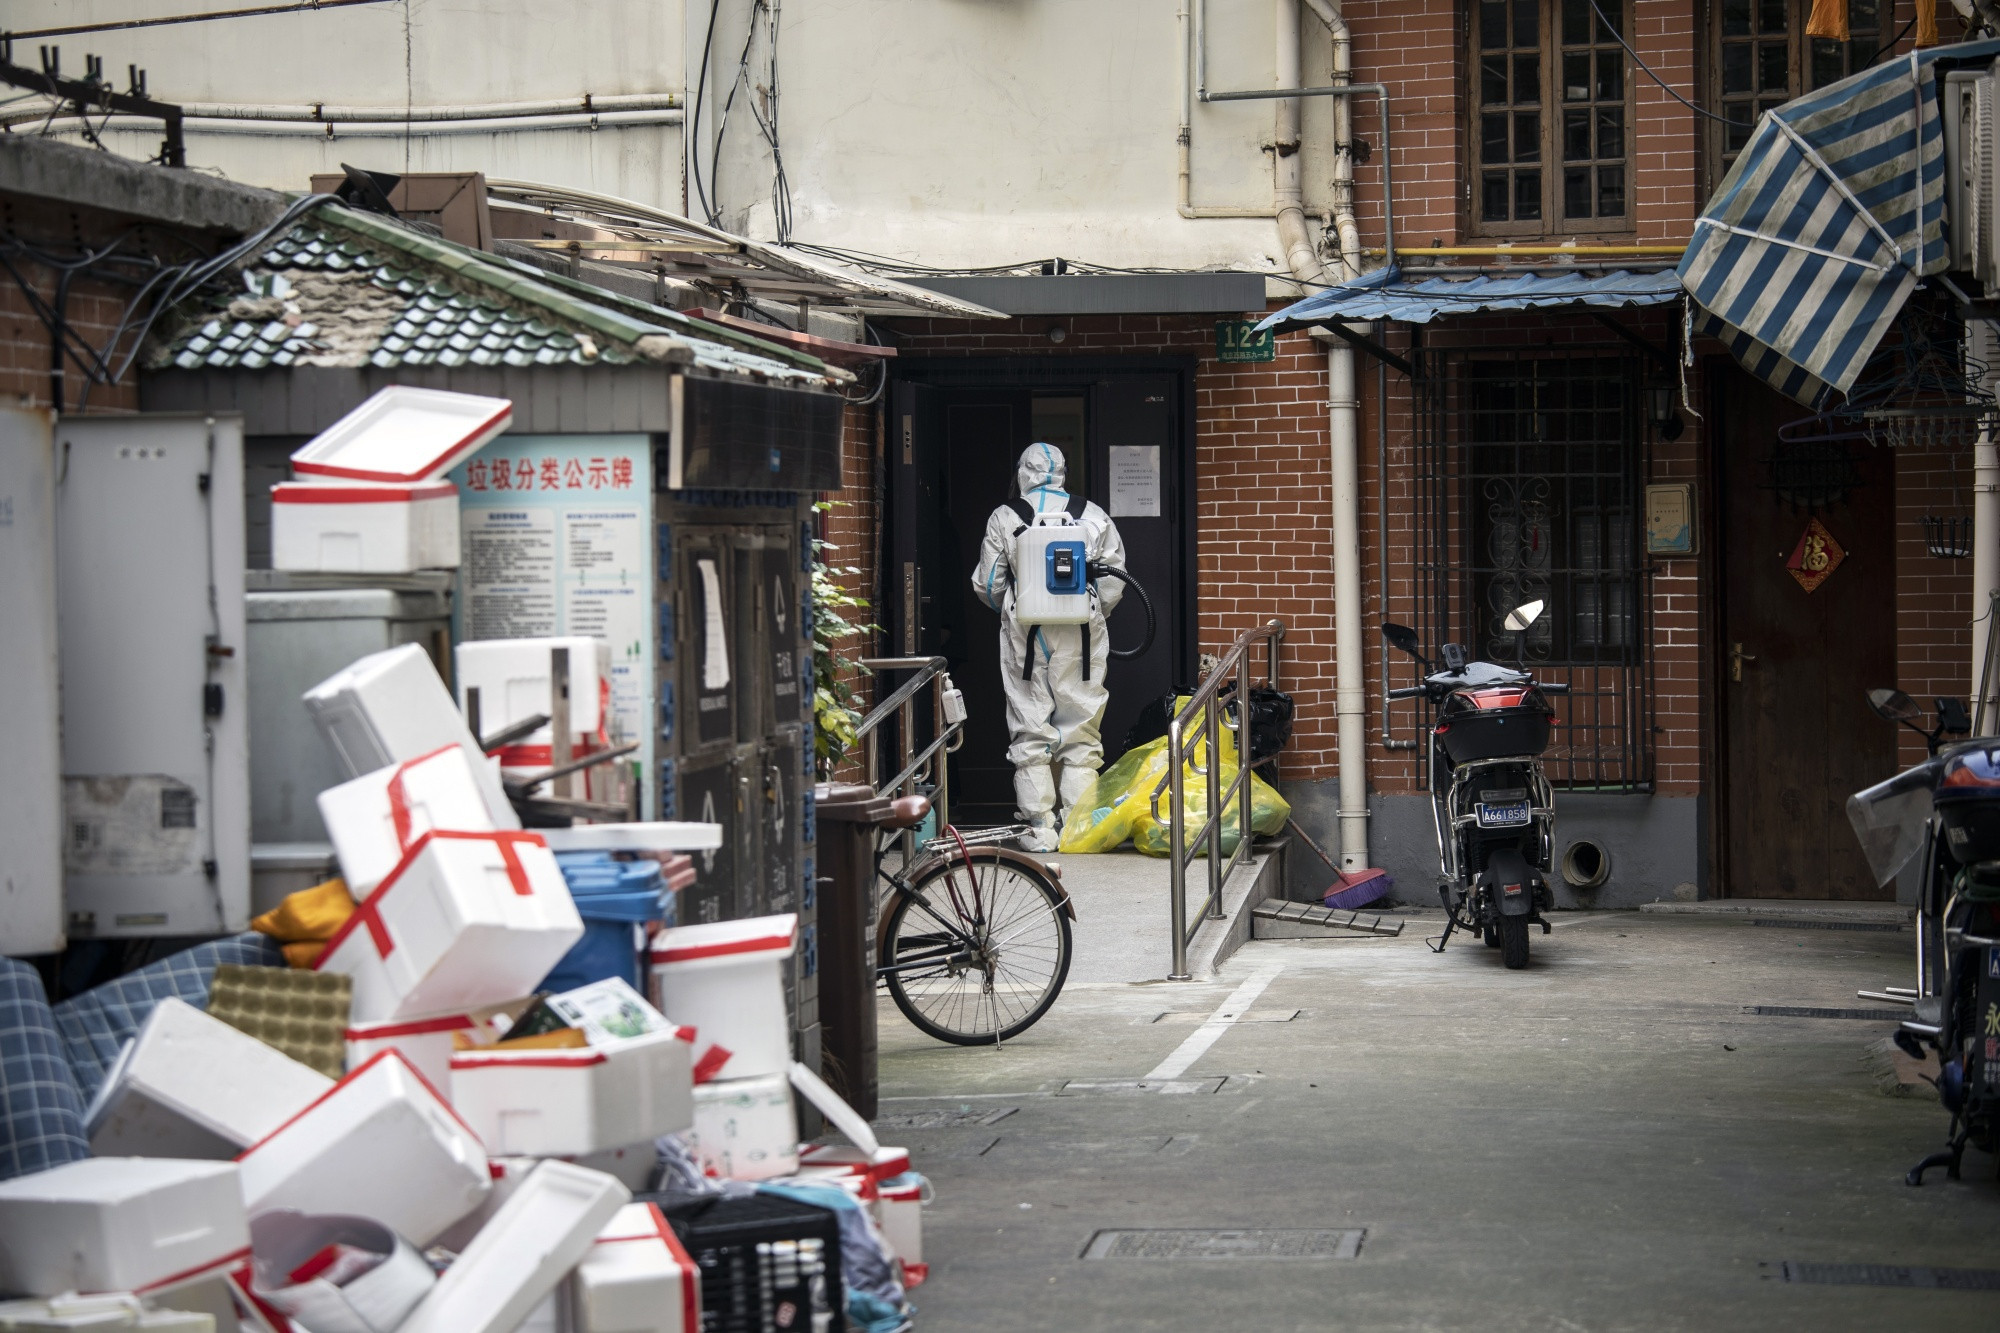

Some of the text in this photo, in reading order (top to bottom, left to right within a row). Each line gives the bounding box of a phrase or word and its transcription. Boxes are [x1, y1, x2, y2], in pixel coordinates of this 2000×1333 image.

[466, 456, 634, 491] 垃圾分类公示牌
[1484, 809, 1526, 821] A661858
